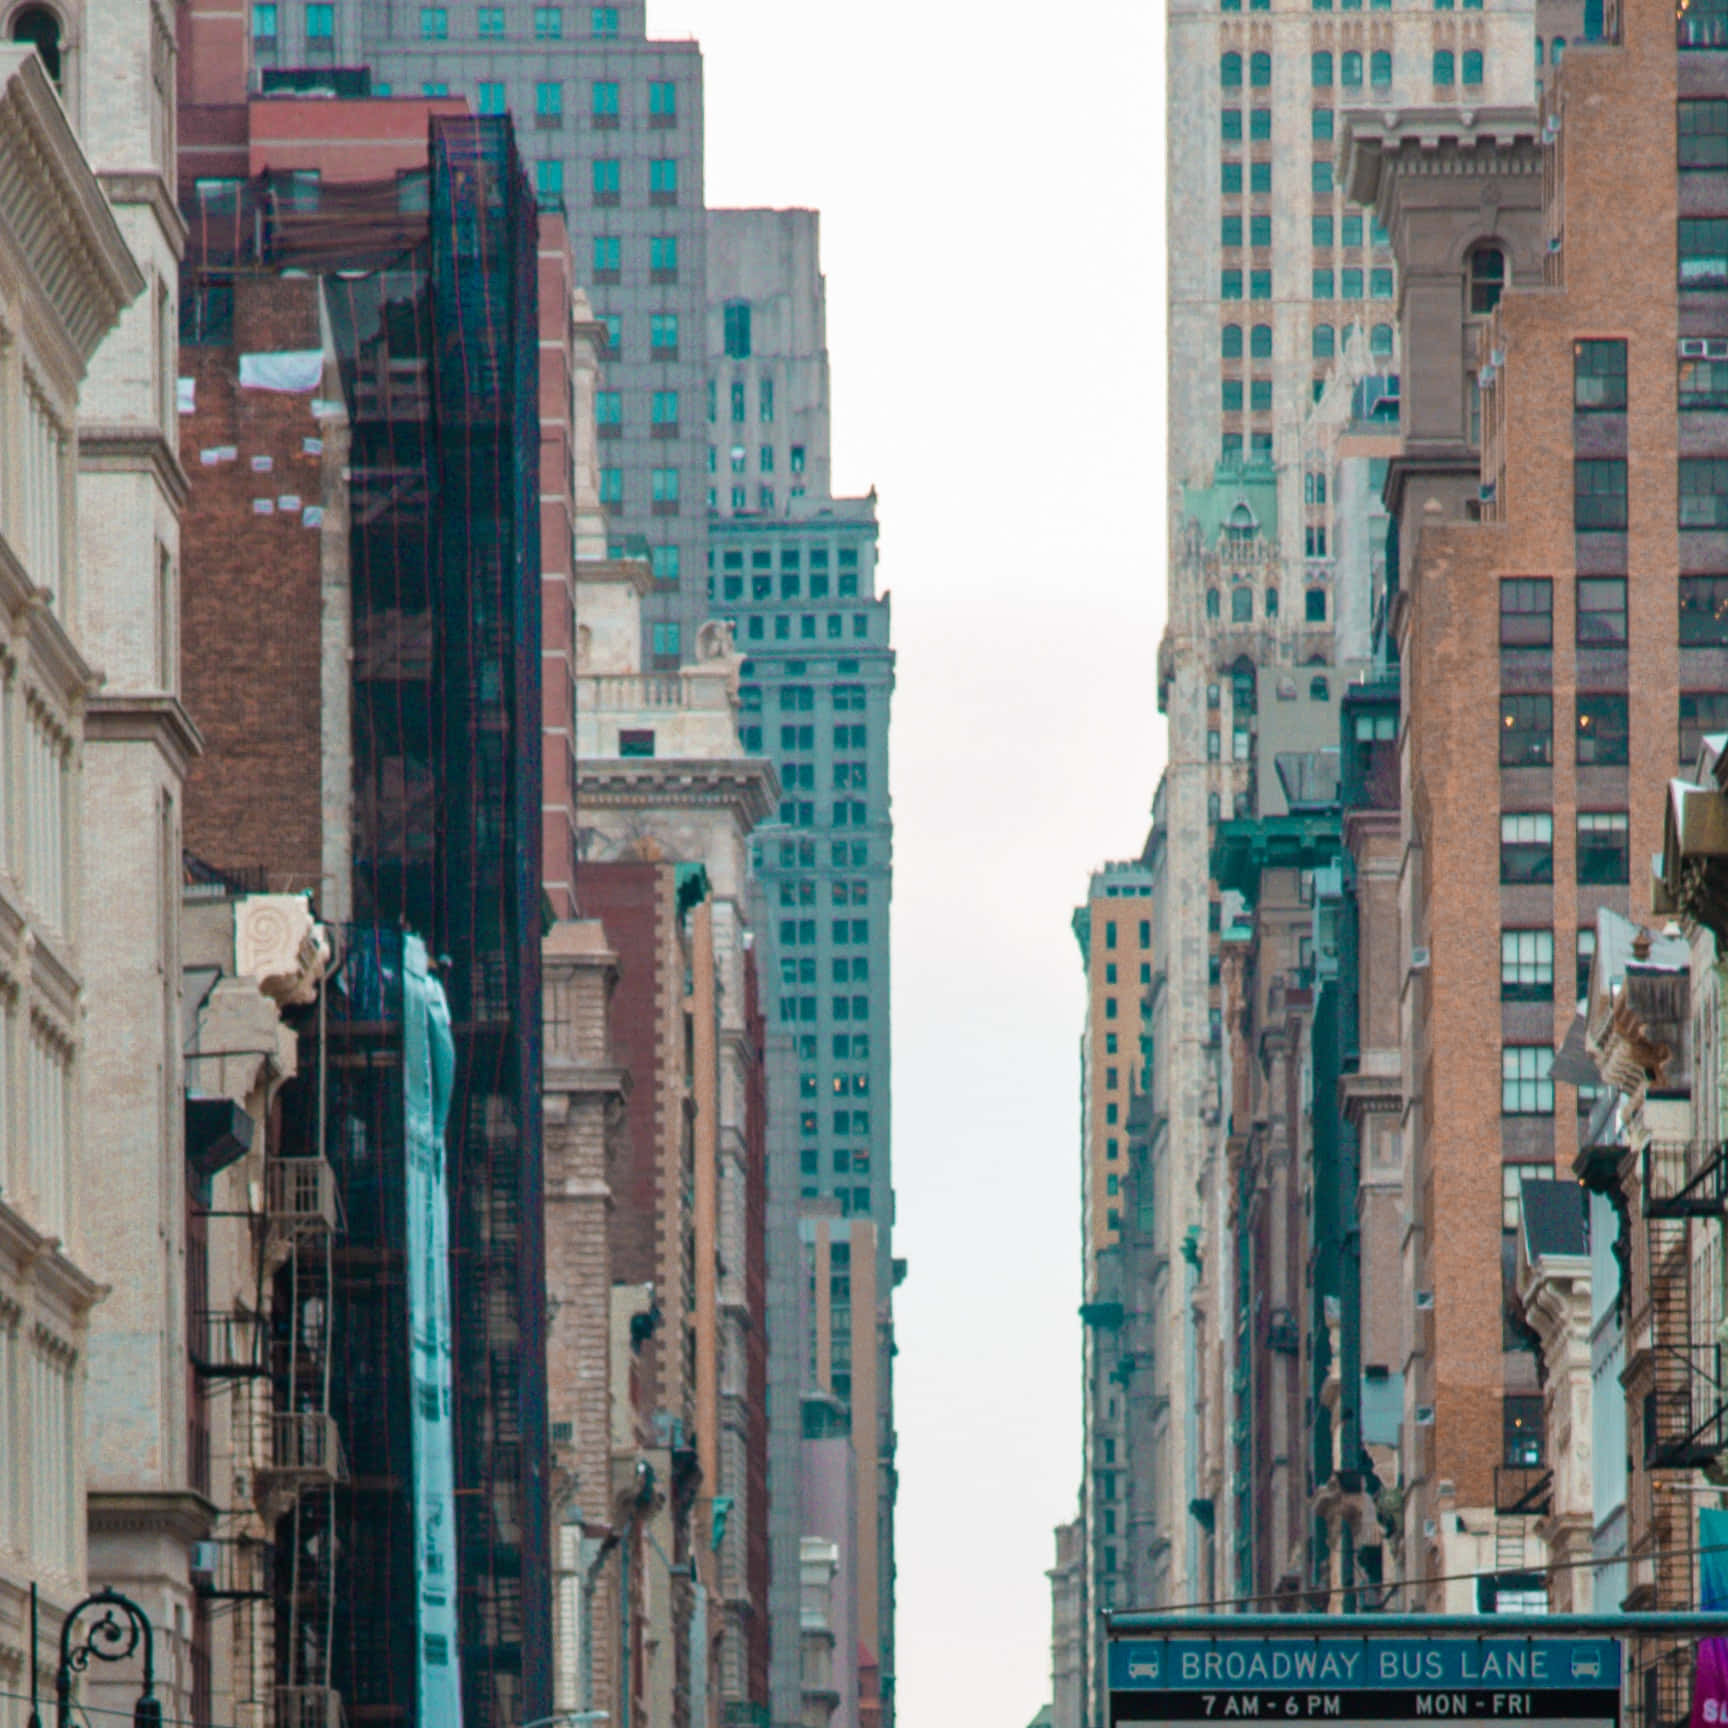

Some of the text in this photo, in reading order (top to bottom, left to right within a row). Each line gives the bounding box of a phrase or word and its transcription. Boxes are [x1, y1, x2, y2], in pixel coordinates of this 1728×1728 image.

[1180, 1650, 1549, 1681] BROADWAY BUS LANE
[1201, 1696, 1342, 1717] 7 AM 6 PM
[1414, 1694, 1532, 1716] MON FRI
